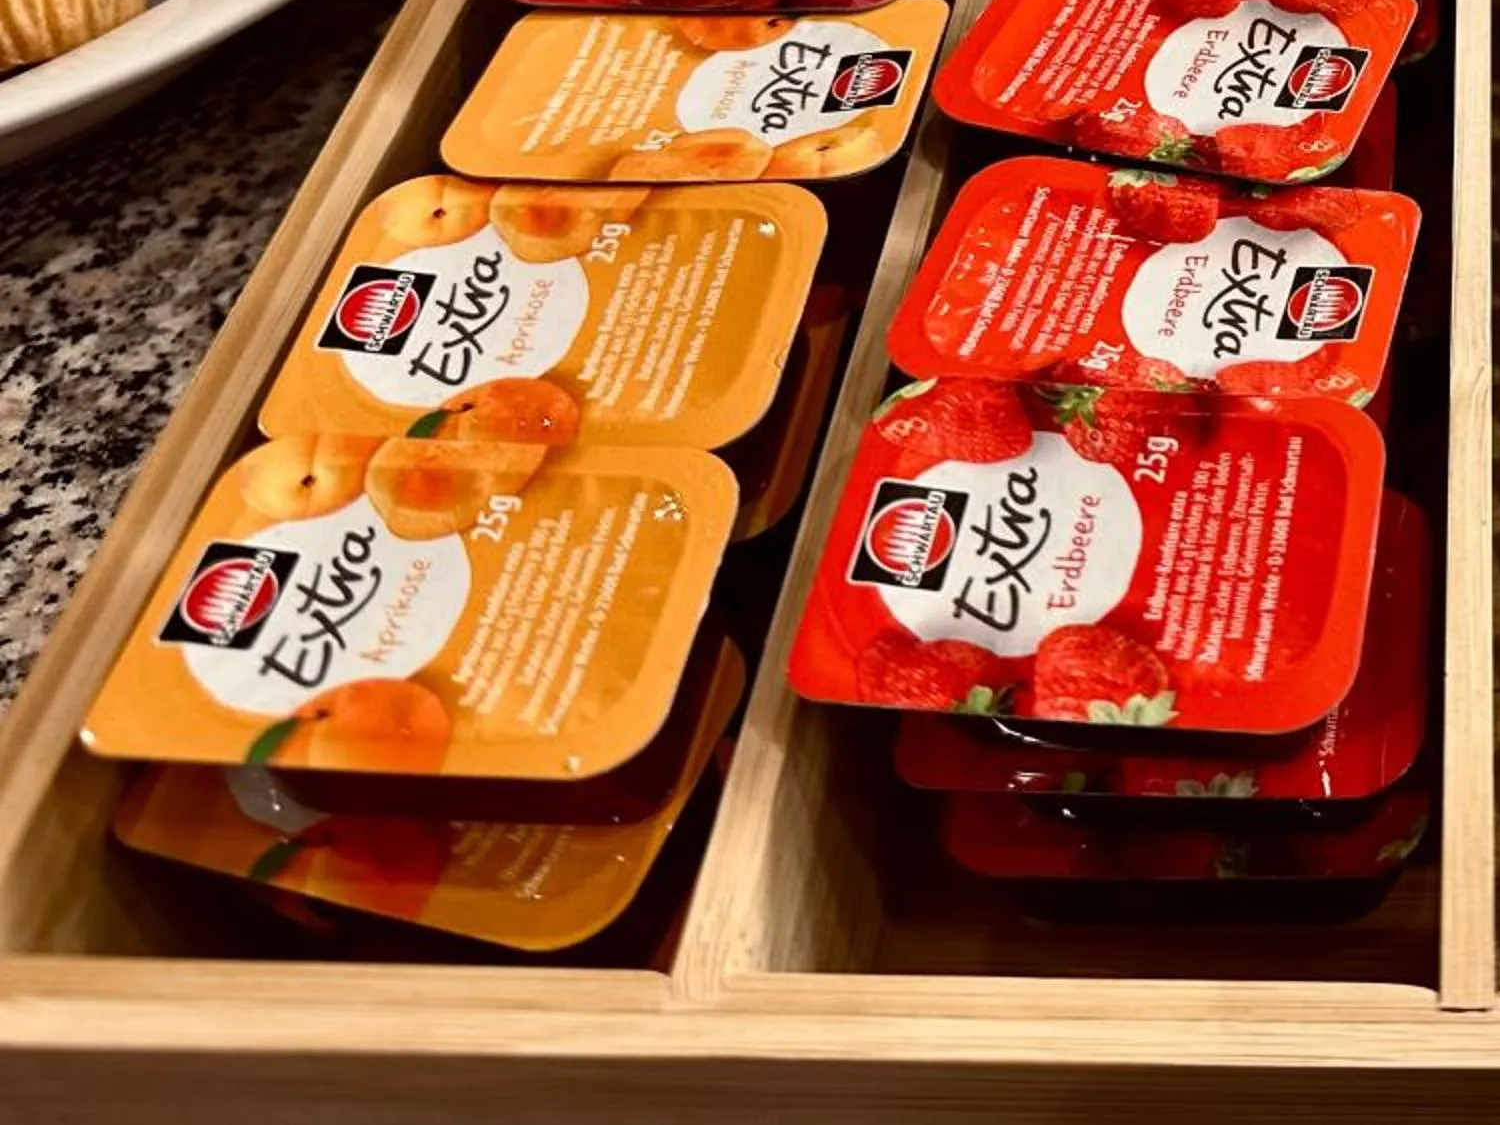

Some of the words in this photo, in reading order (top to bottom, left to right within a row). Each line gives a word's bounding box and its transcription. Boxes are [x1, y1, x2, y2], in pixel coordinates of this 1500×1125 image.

[709, 59, 747, 121] Aprikose
[750, 40, 832, 134] Extra
[1172, 28, 1230, 98] Erdbeere
[1213, 17, 1297, 121] Extra
[1098, 97, 1144, 124] 25g
[586, 221, 632, 264] 25g
[364, 273, 414, 353] SCHWARTAU
[407, 251, 510, 386] Extra
[495, 278, 556, 367] Aprikose
[1156, 254, 1209, 338] Erdbeere
[1202, 237, 1290, 359] Extra
[1077, 339, 1127, 373] 25g
[1132, 434, 1181, 485] 25g
[469, 494, 523, 543] 25g
[901, 491, 947, 589] SCHWARTAU
[952, 466, 1052, 632] Extra
[1046, 492, 1102, 612] Erdbeere
[259, 524, 383, 688] Extra
[358, 557, 432, 665] Aprikose
